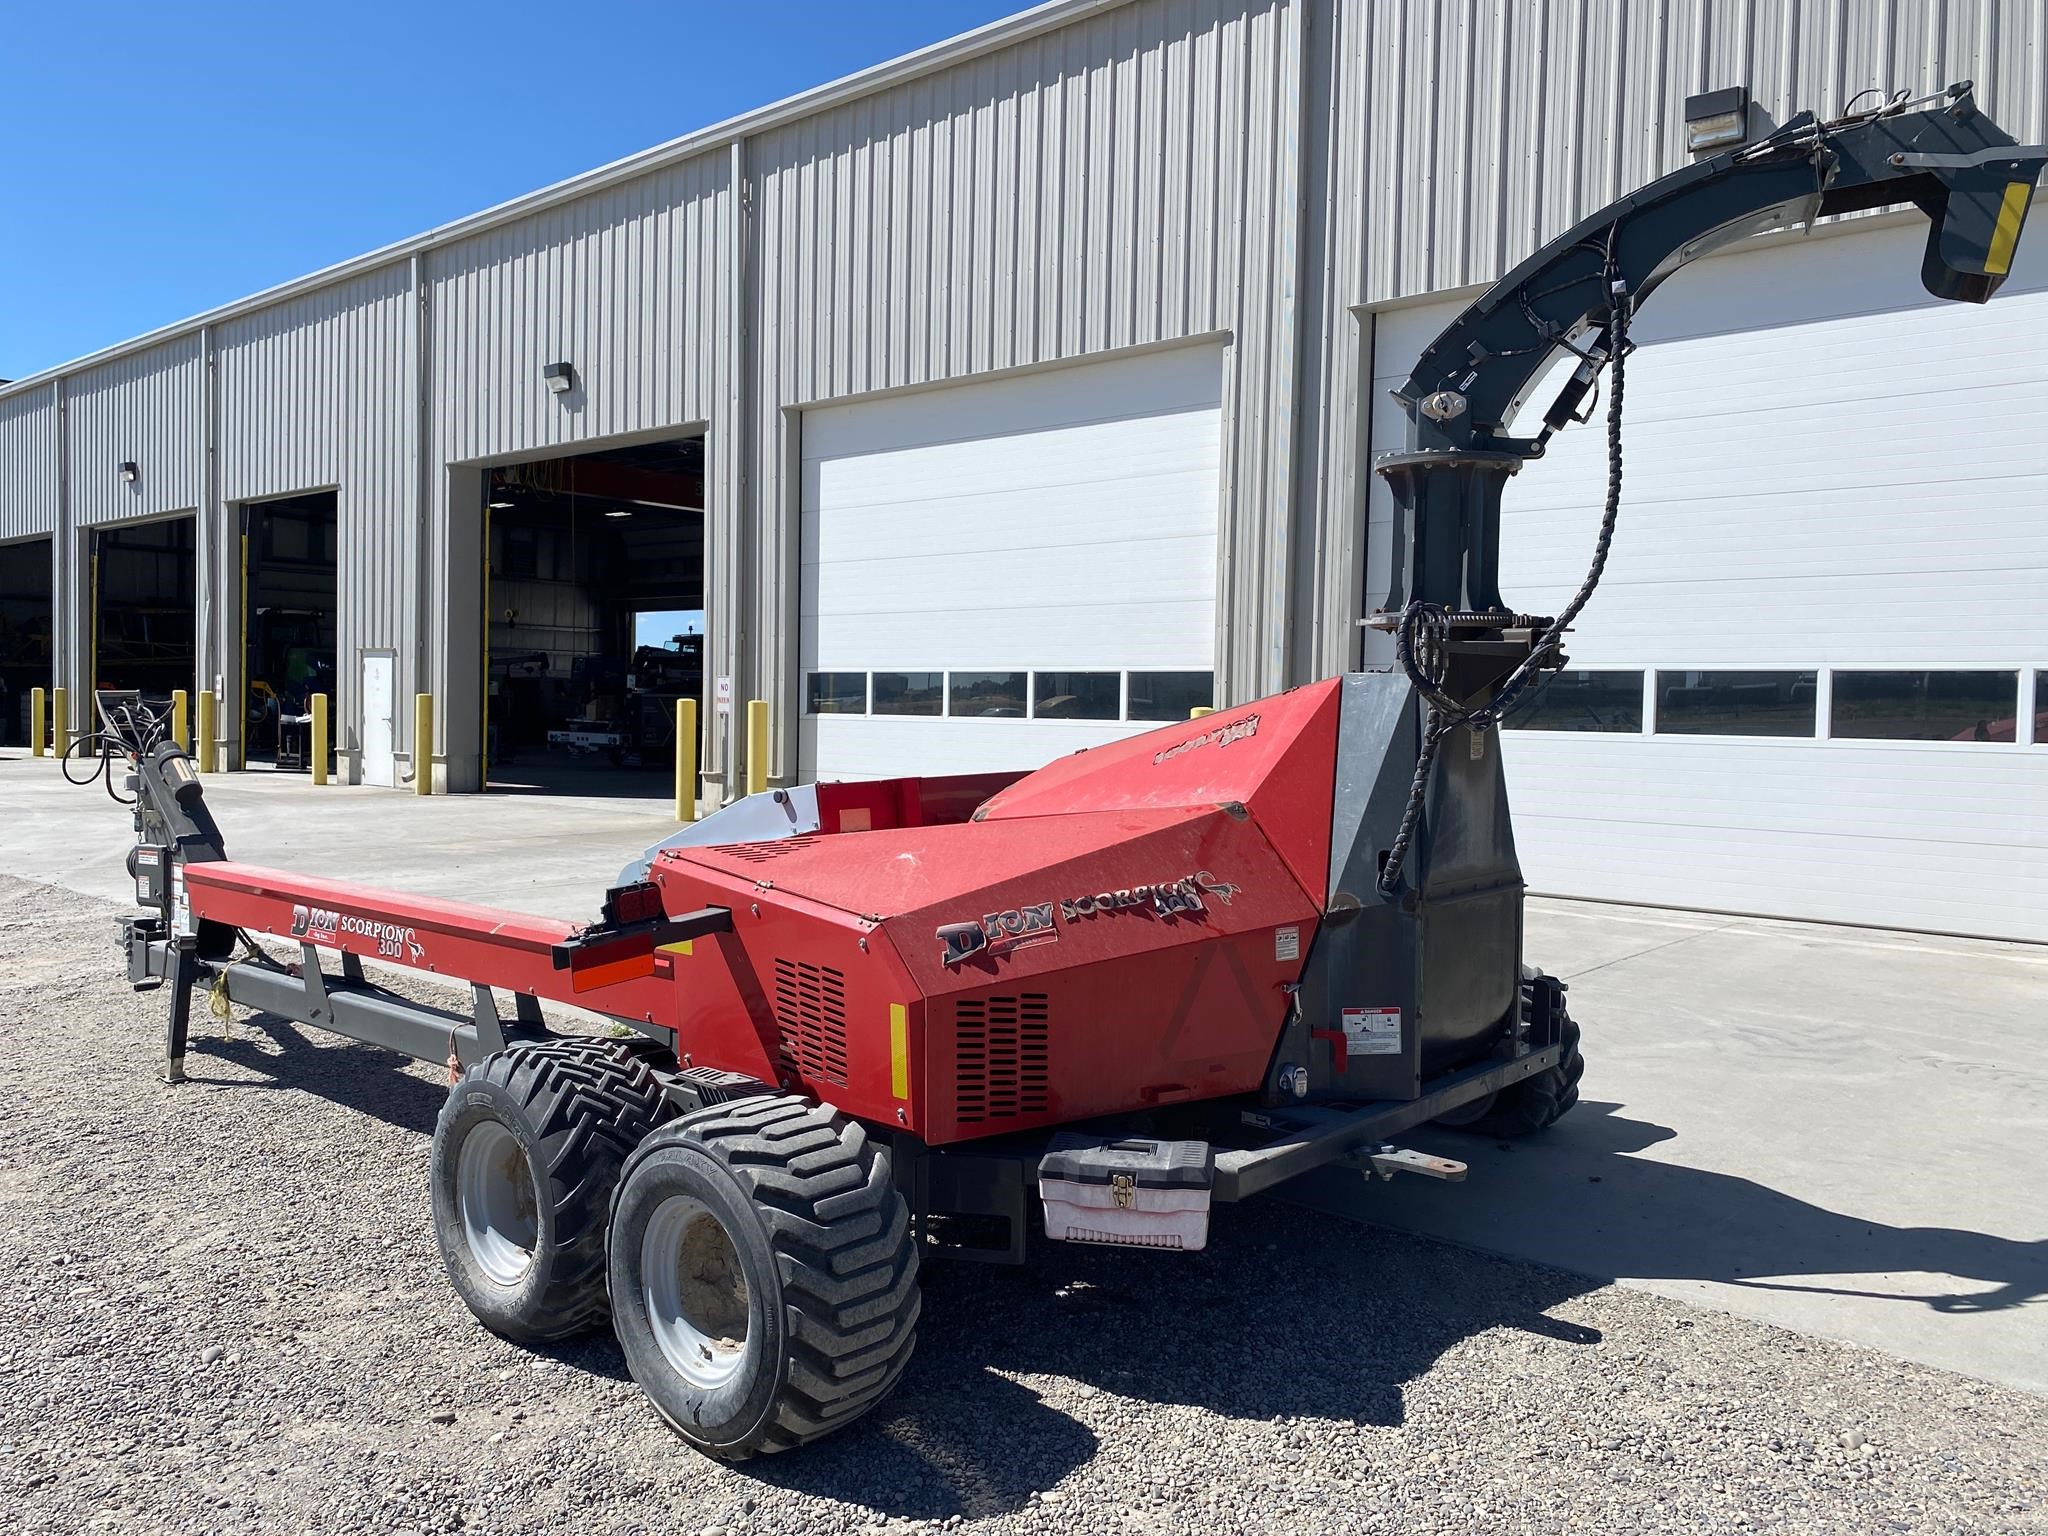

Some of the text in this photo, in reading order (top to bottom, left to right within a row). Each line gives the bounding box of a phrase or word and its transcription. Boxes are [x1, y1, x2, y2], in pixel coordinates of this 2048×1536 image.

[720, 683, 729, 692] NO
[291, 904, 405, 943] DION SCORPION
[936, 902, 1054, 968] DION
[379, 938, 402, 958] 300
